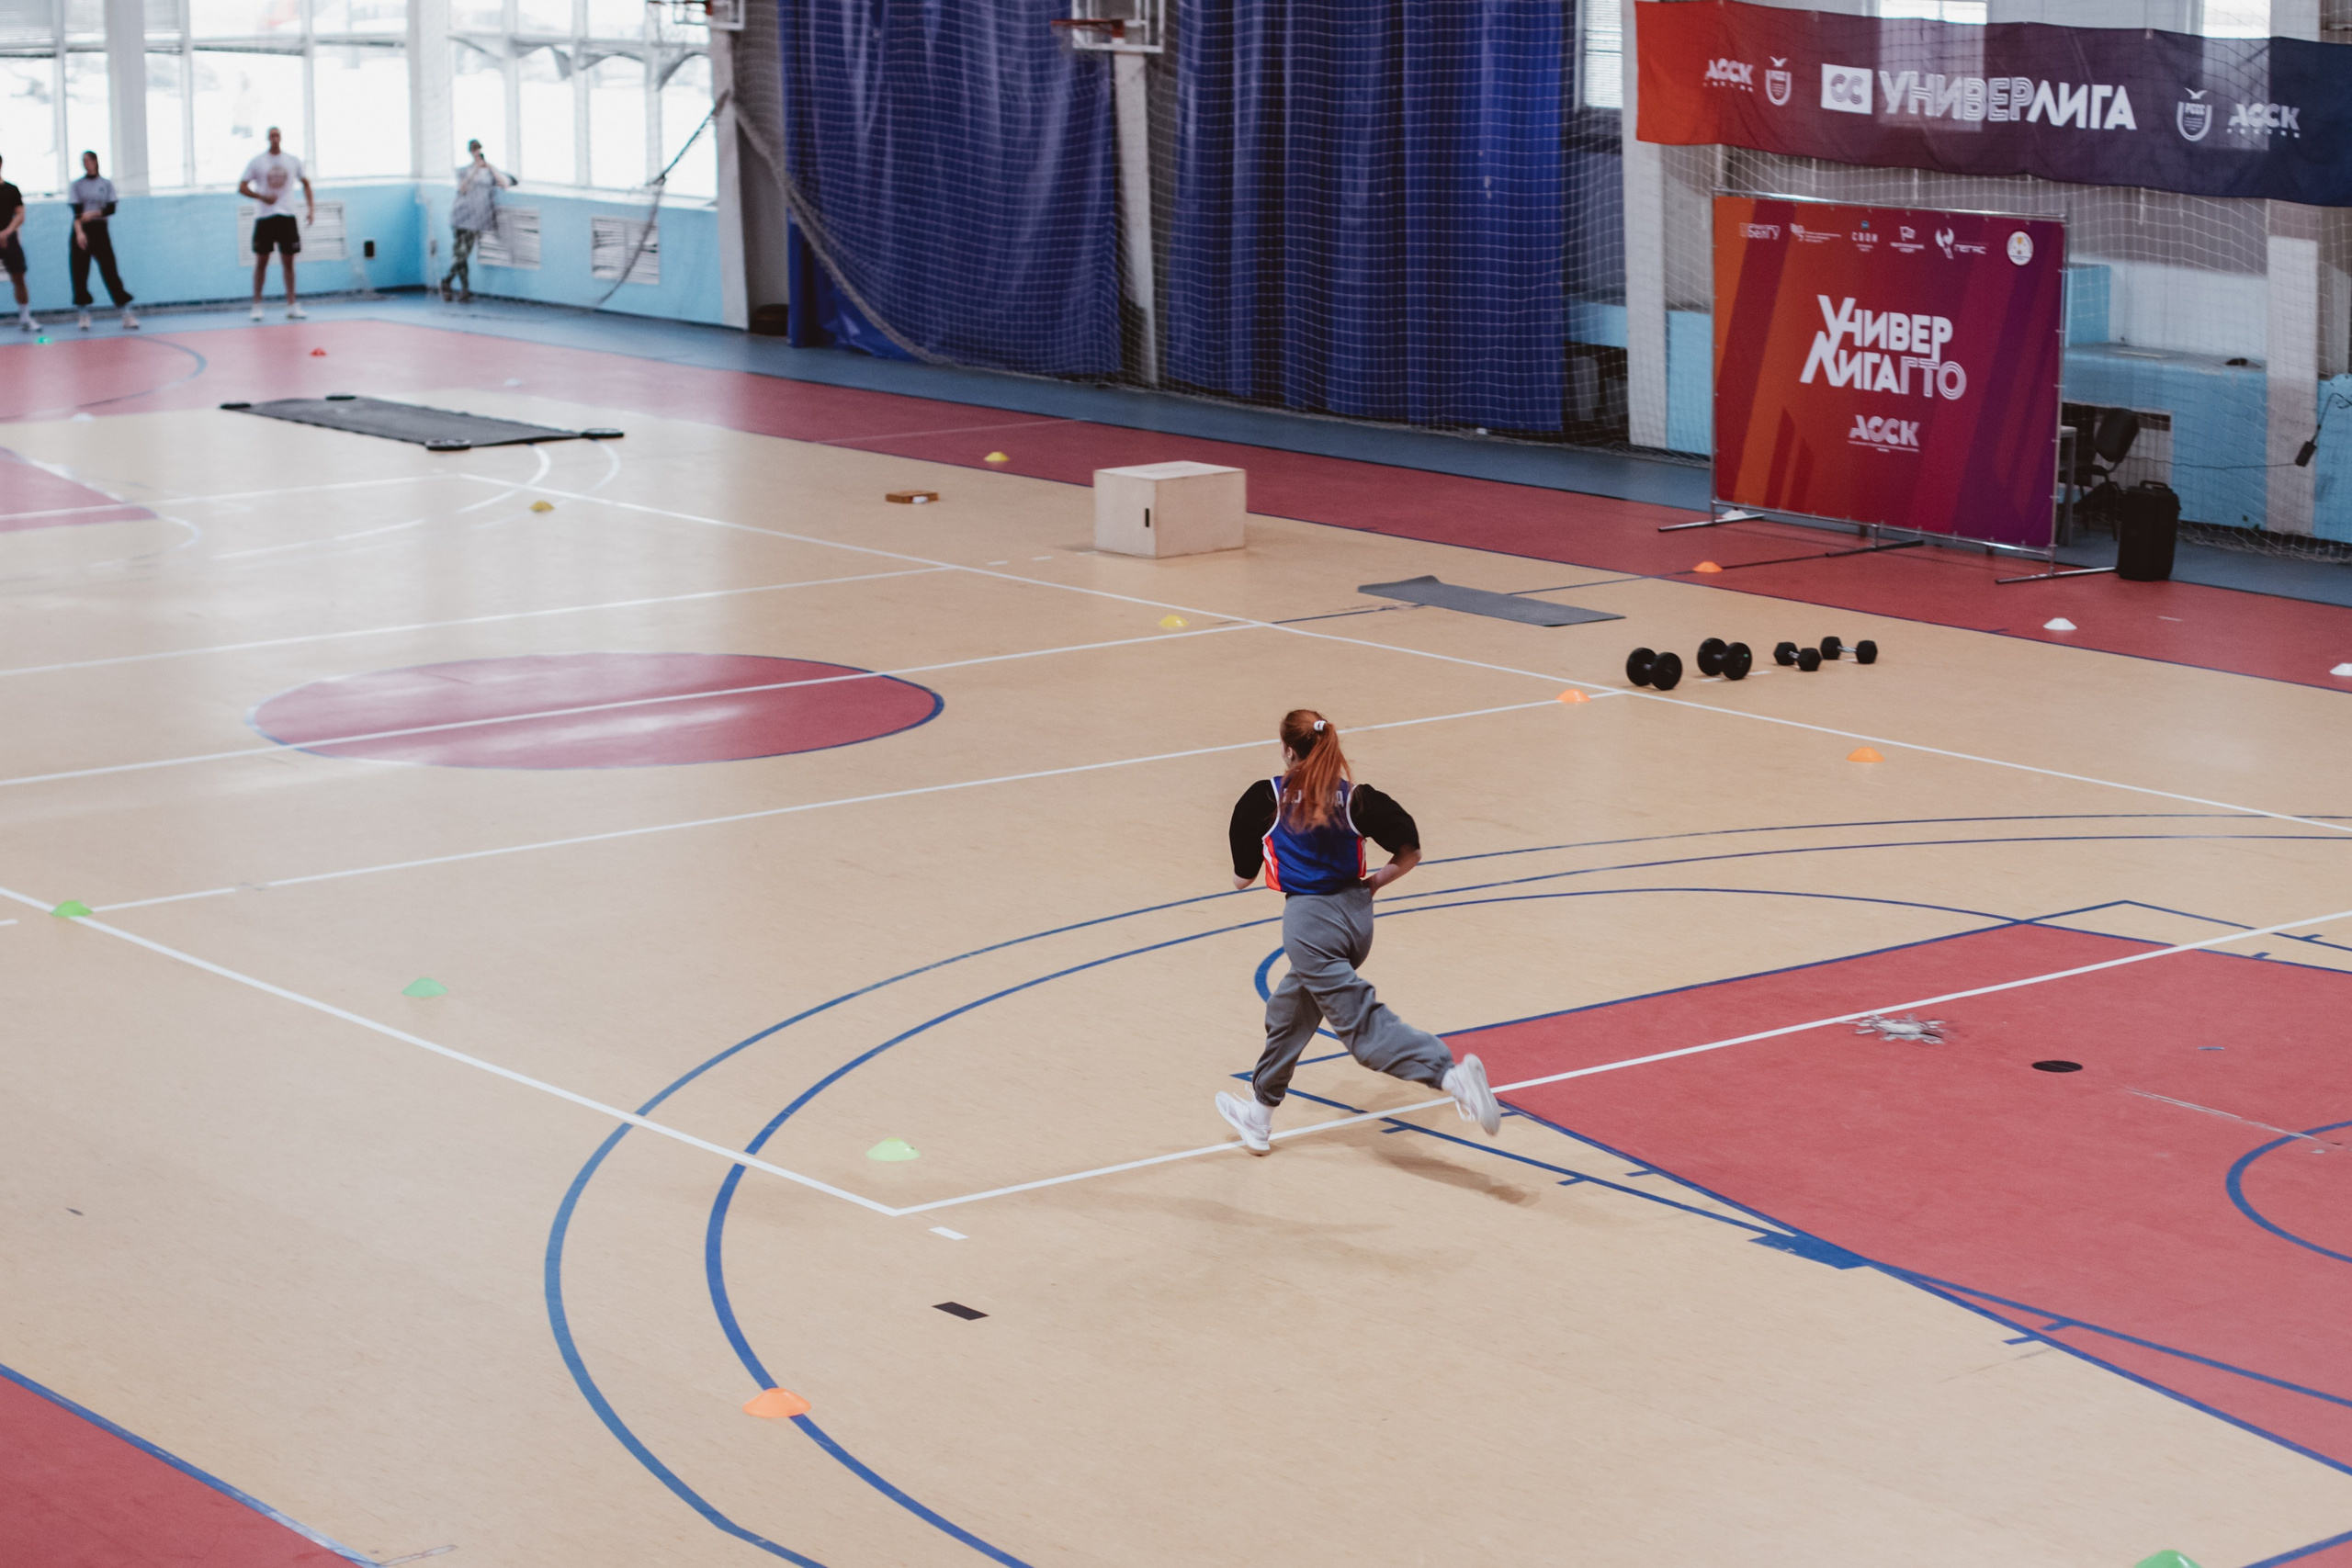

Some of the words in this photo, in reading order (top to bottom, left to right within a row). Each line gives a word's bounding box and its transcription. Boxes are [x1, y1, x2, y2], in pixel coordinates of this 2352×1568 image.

[1878, 70, 2138, 130] УНИВЕРЛИГА
[2227, 102, 2301, 130] АССК
[1817, 294, 1954, 366] УНИВЕР
[1848, 414, 1920, 446] АССК
